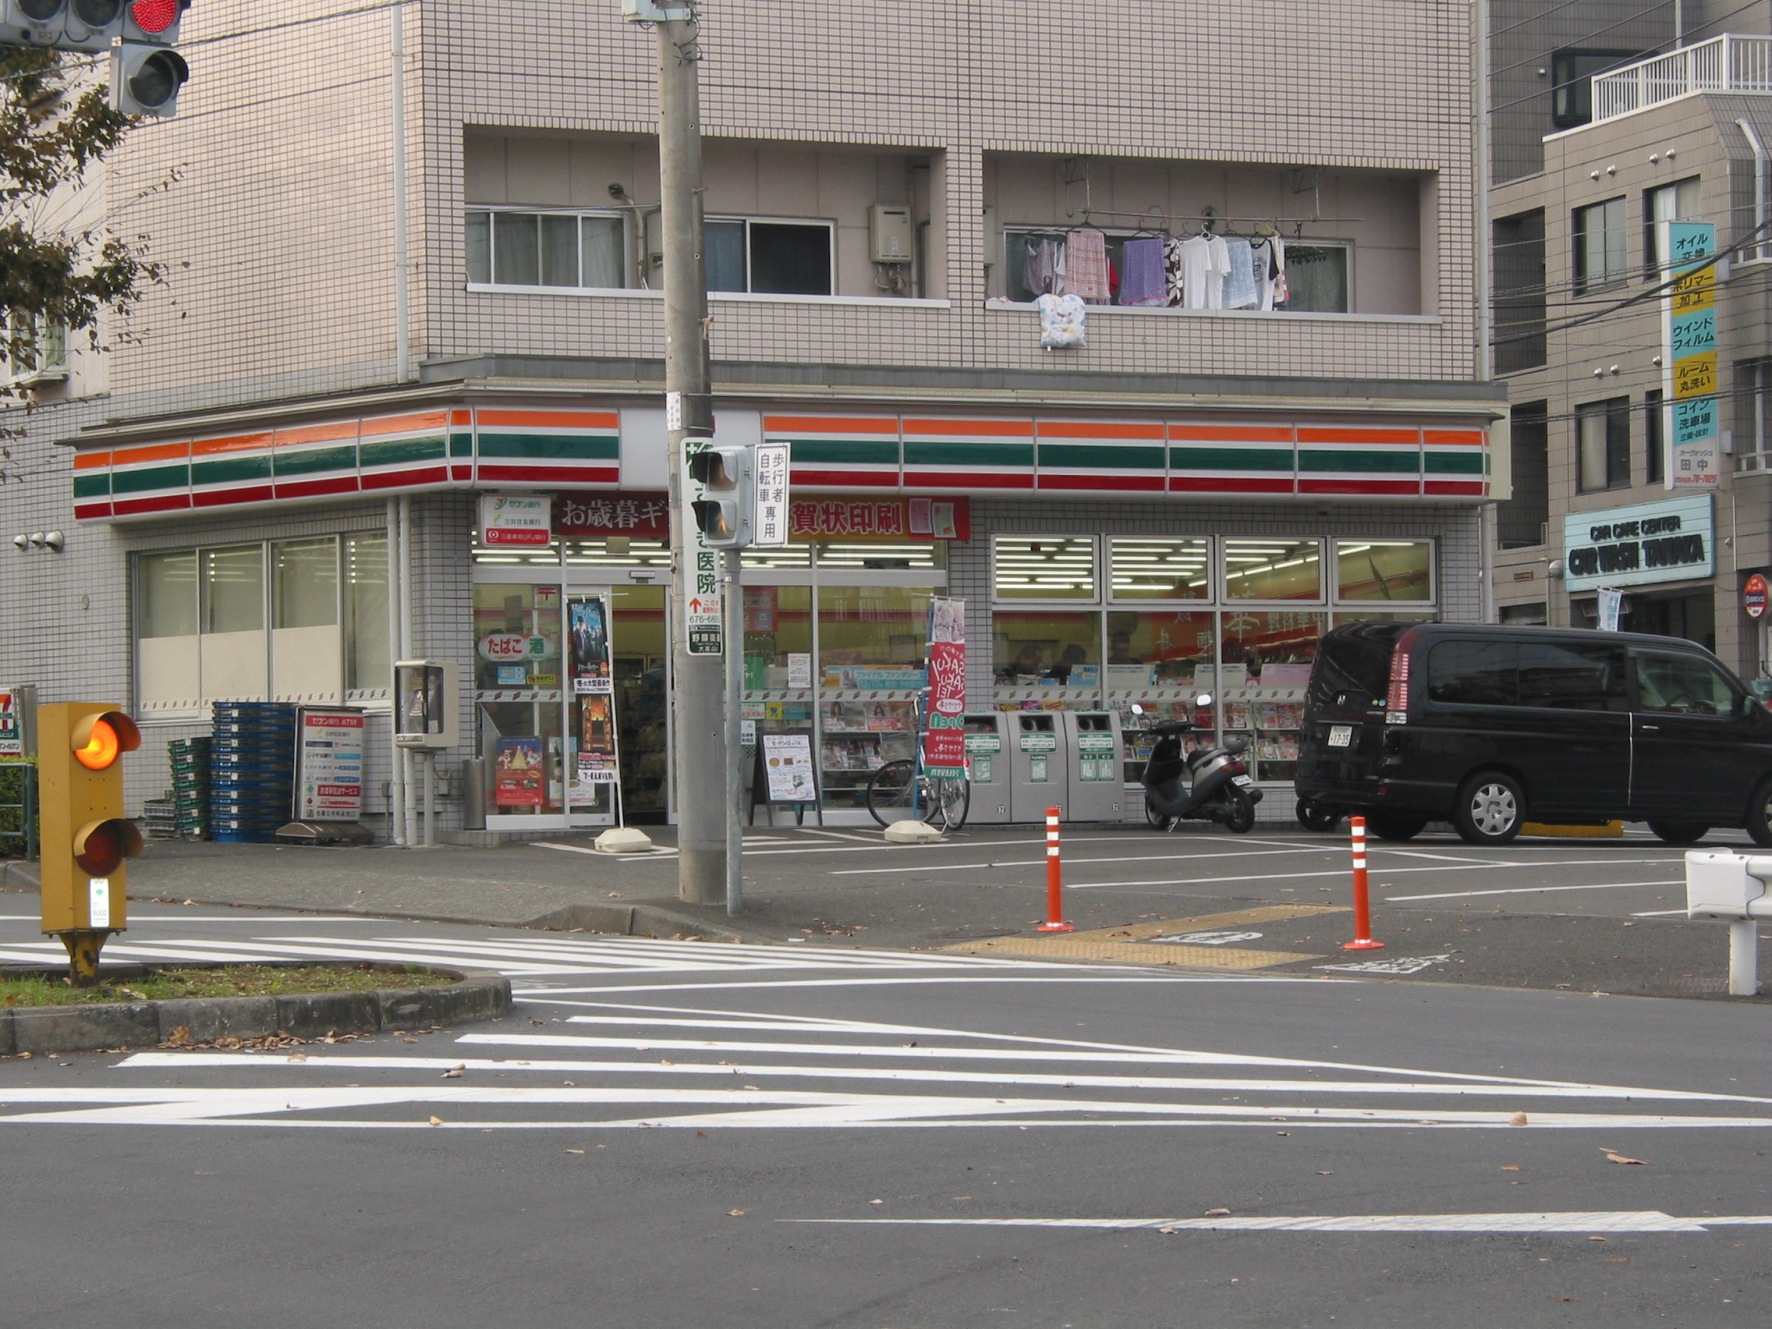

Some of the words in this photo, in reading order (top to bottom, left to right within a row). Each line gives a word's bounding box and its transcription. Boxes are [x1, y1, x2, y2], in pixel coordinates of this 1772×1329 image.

[1676, 233, 1709, 250] オイル
[1679, 292, 1704, 308] 加工
[1673, 332, 1714, 351] フィルム
[1679, 362, 1709, 378] ルーム
[1679, 375, 1711, 393] 丸洗い
[1678, 400, 1710, 416] コイン
[1679, 412, 1711, 431] 洗車場
[562, 500, 669, 529] お歳暮ギ
[764, 506, 777, 539] 専用
[791, 501, 903, 535] 賀状印刷
[488, 638, 523, 654] たばこ
[529, 637, 545, 654] 酒
